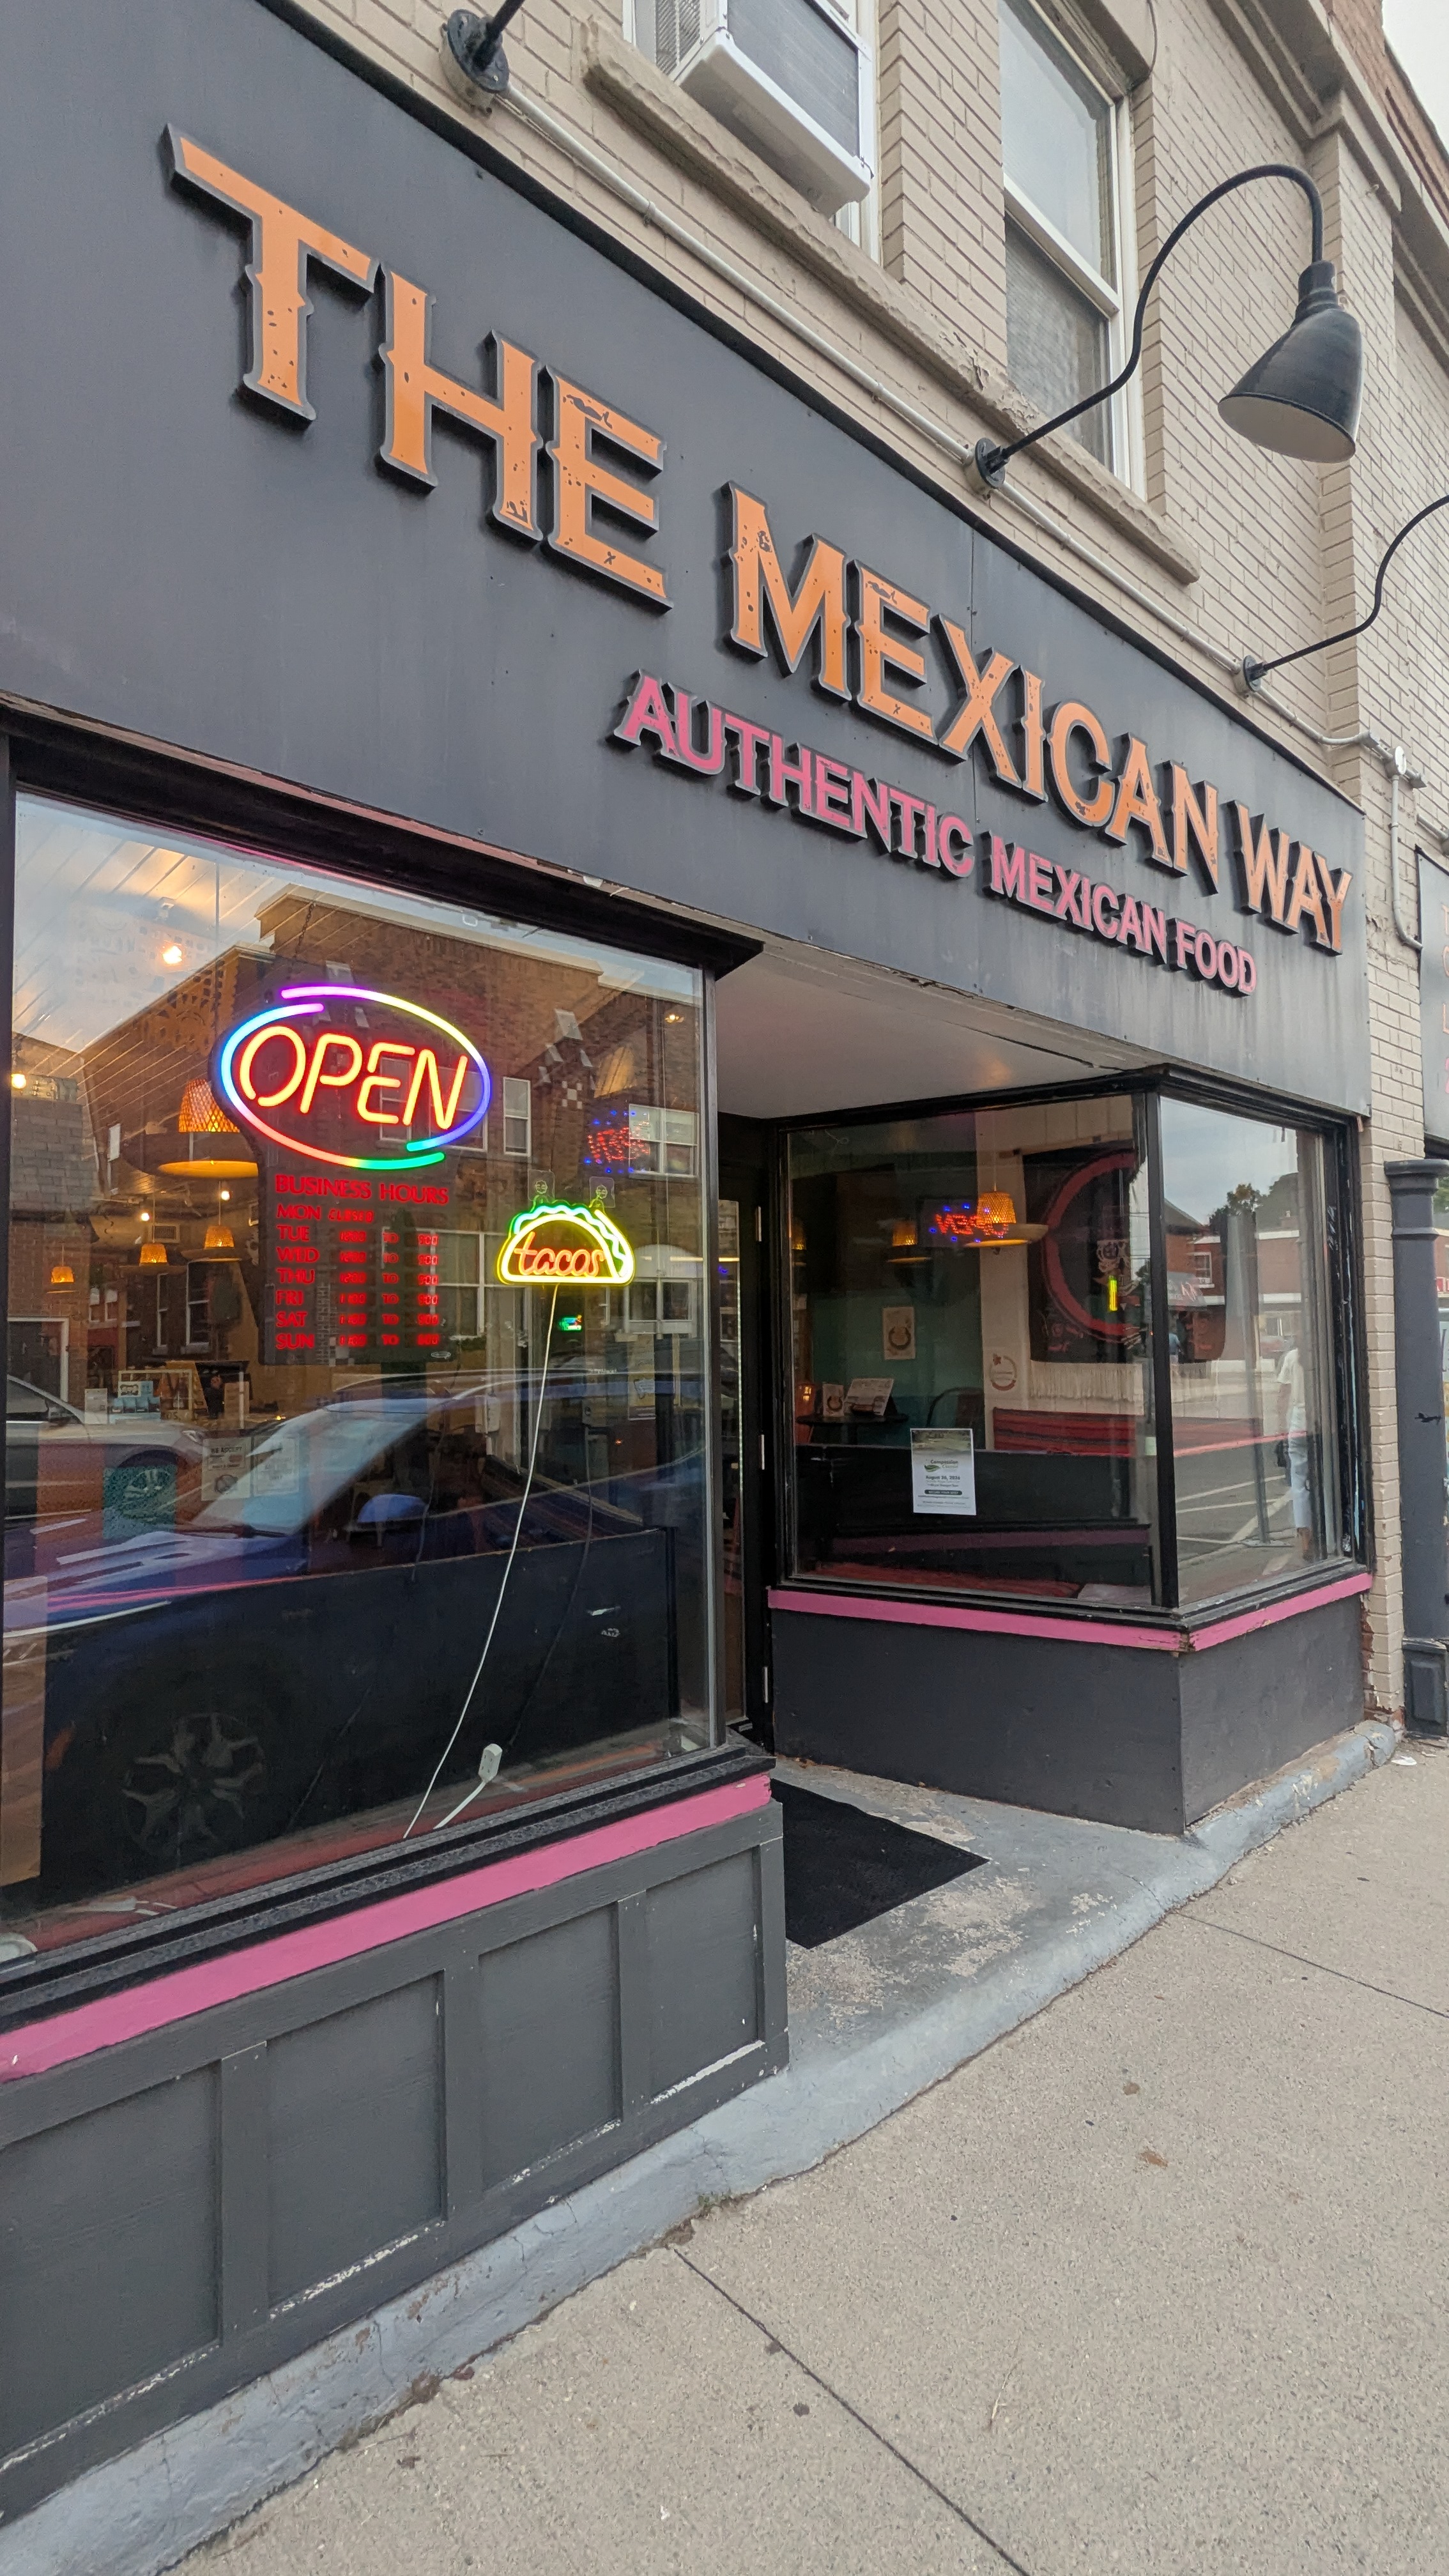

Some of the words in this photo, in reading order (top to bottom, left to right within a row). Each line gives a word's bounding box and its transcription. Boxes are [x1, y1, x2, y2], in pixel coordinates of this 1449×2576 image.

[164, 123, 673, 611] THE
[722, 480, 1219, 894] MEXICAN
[1230, 800, 1353, 955] WAY
[611, 669, 975, 877] AUTHENTIC
[985, 831, 1167, 963] MEXICAN
[1172, 917, 1257, 996] FOOD
[240, 1025, 468, 1130] OPEN
[275, 1174, 372, 1199] BUSINESS
[379, 1183, 448, 1205] HOURS
[277, 1204, 321, 1220] MON
[328, 1209, 374, 1223] CLOSED
[277, 1225, 310, 1241] TUE
[382, 1232, 399, 1243] TO
[277, 1246, 319, 1263] WED
[382, 1252, 399, 1264] TO
[513, 1231, 606, 1277] tacos
[277, 1268, 315, 1284] THU
[382, 1272, 399, 1284] TO
[276, 1290, 303, 1305] FRI
[382, 1293, 399, 1305] TO
[276, 1311, 308, 1327] SAT
[381, 1314, 399, 1325] TO
[276, 1333, 315, 1349] SUN
[381, 1334, 399, 1346] TO
